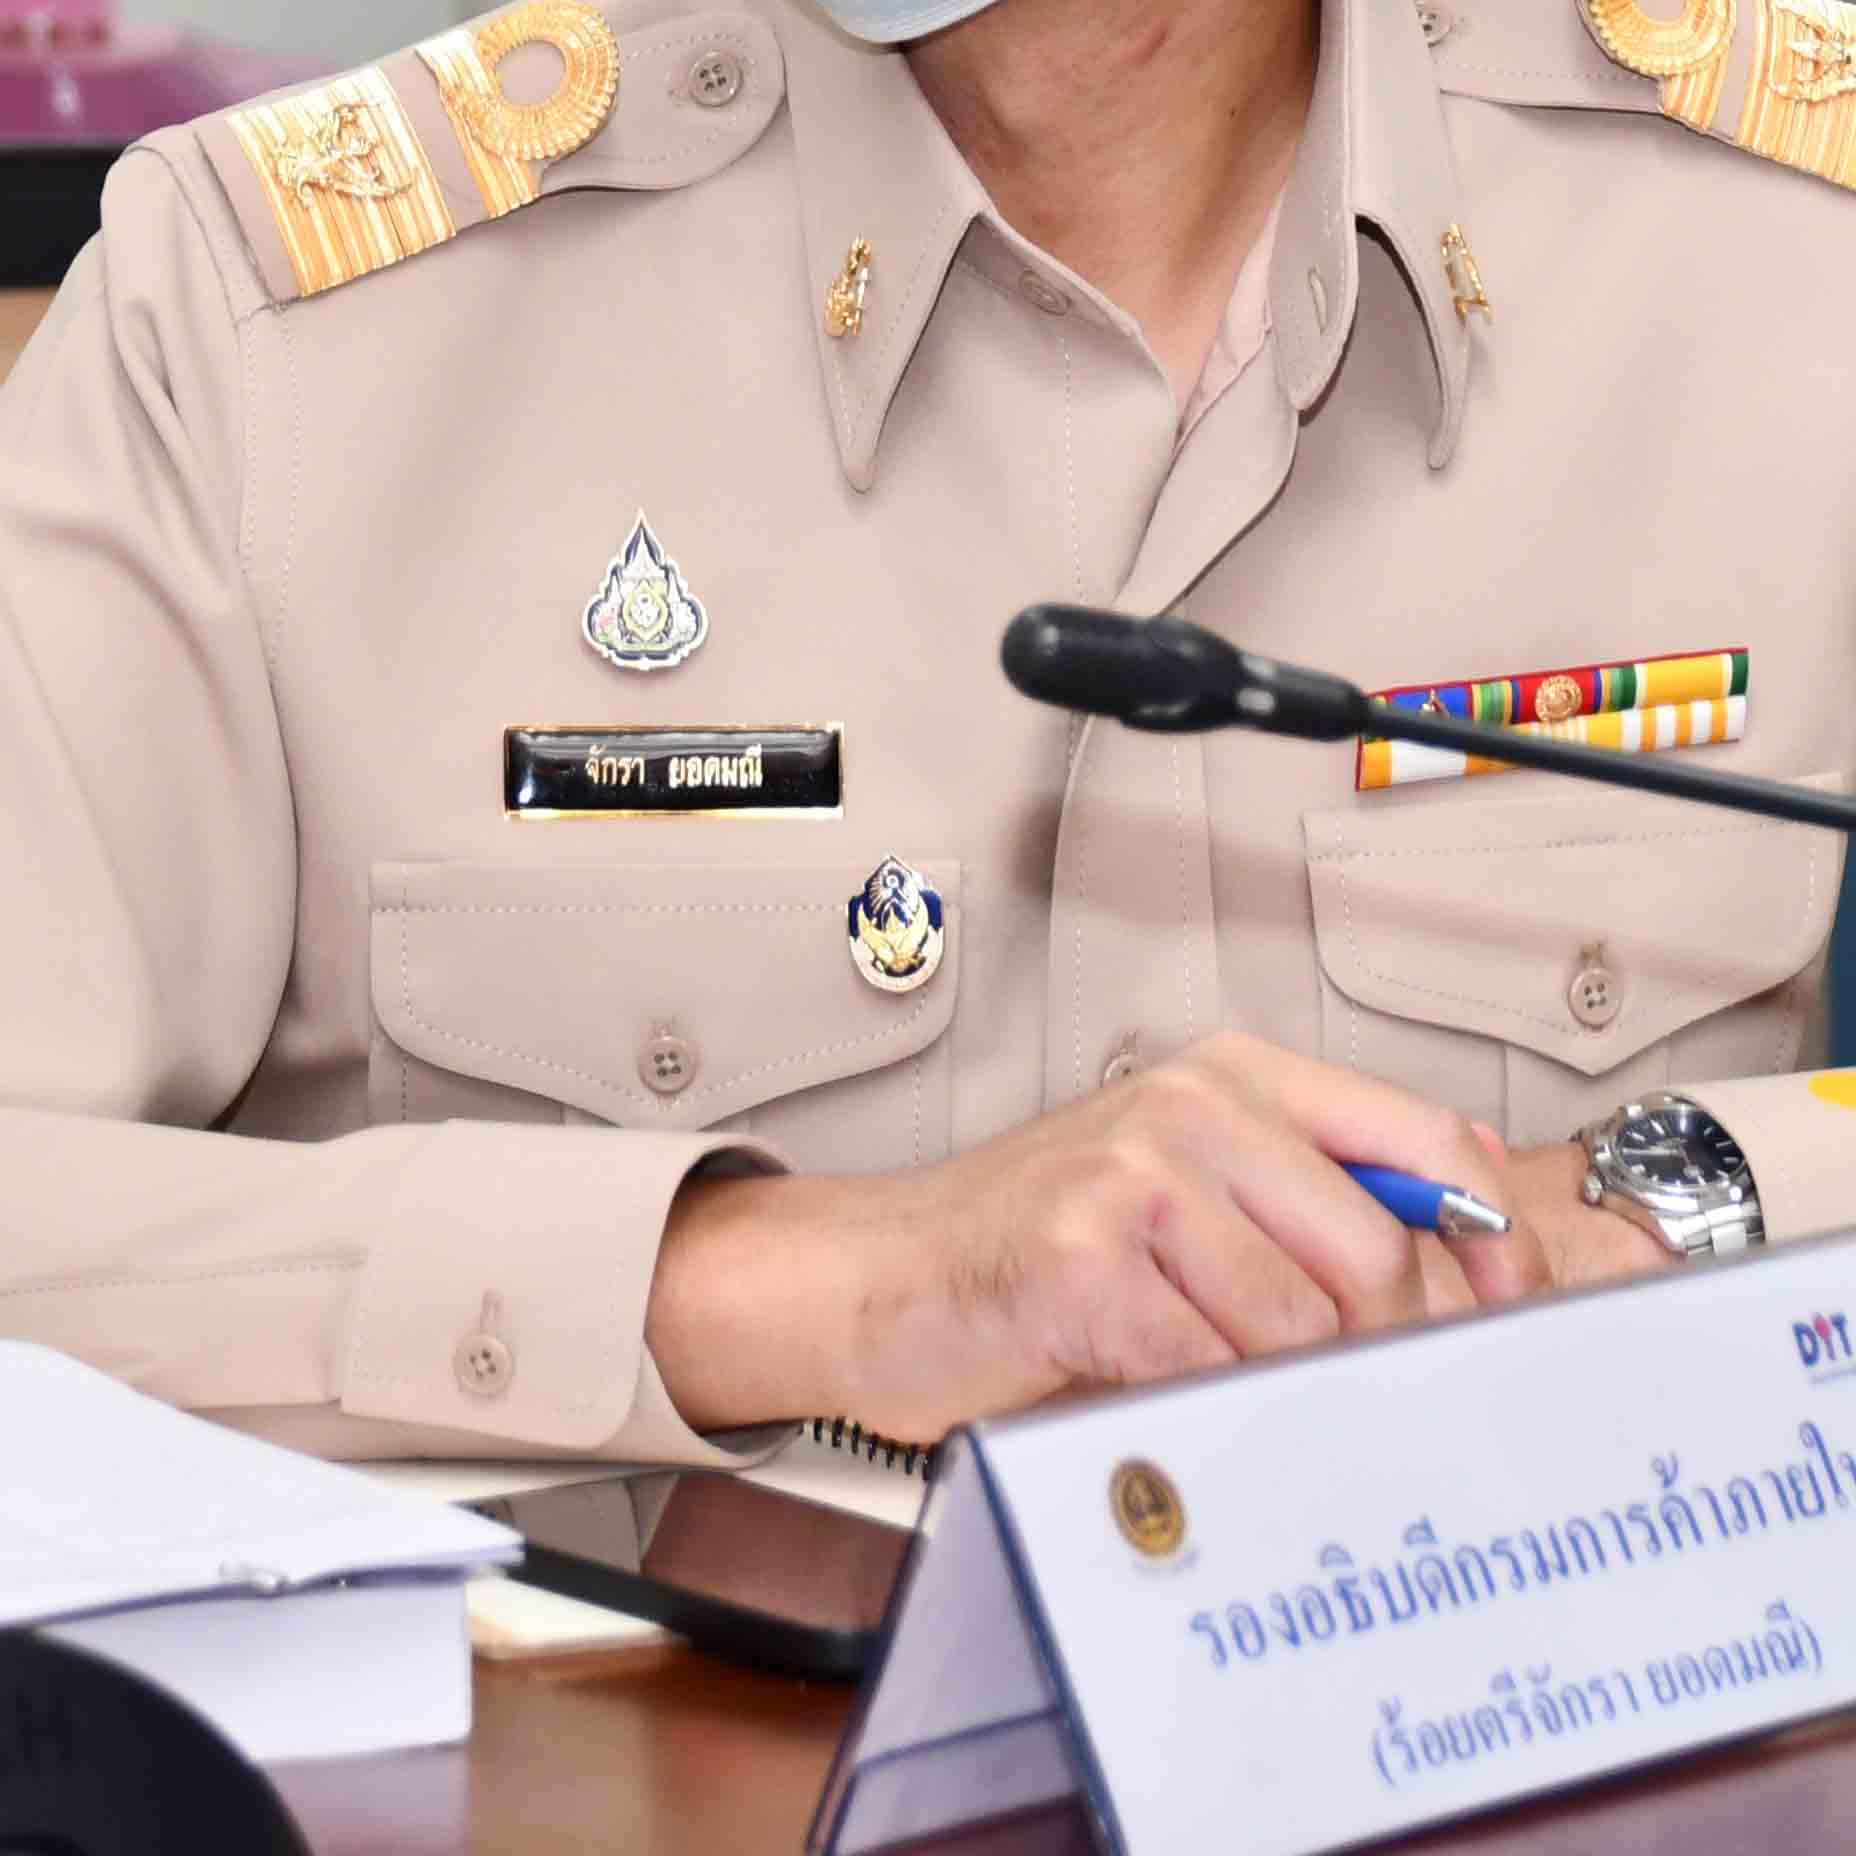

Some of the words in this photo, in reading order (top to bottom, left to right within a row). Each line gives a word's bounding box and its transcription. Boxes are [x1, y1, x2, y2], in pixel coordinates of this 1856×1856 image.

[585, 744, 646, 787] จักรา
[668, 744, 763, 789] ยอดมณี
[1792, 1312, 1853, 1367] DIT
[1648, 1600, 1825, 1706] ยอดมณี)
